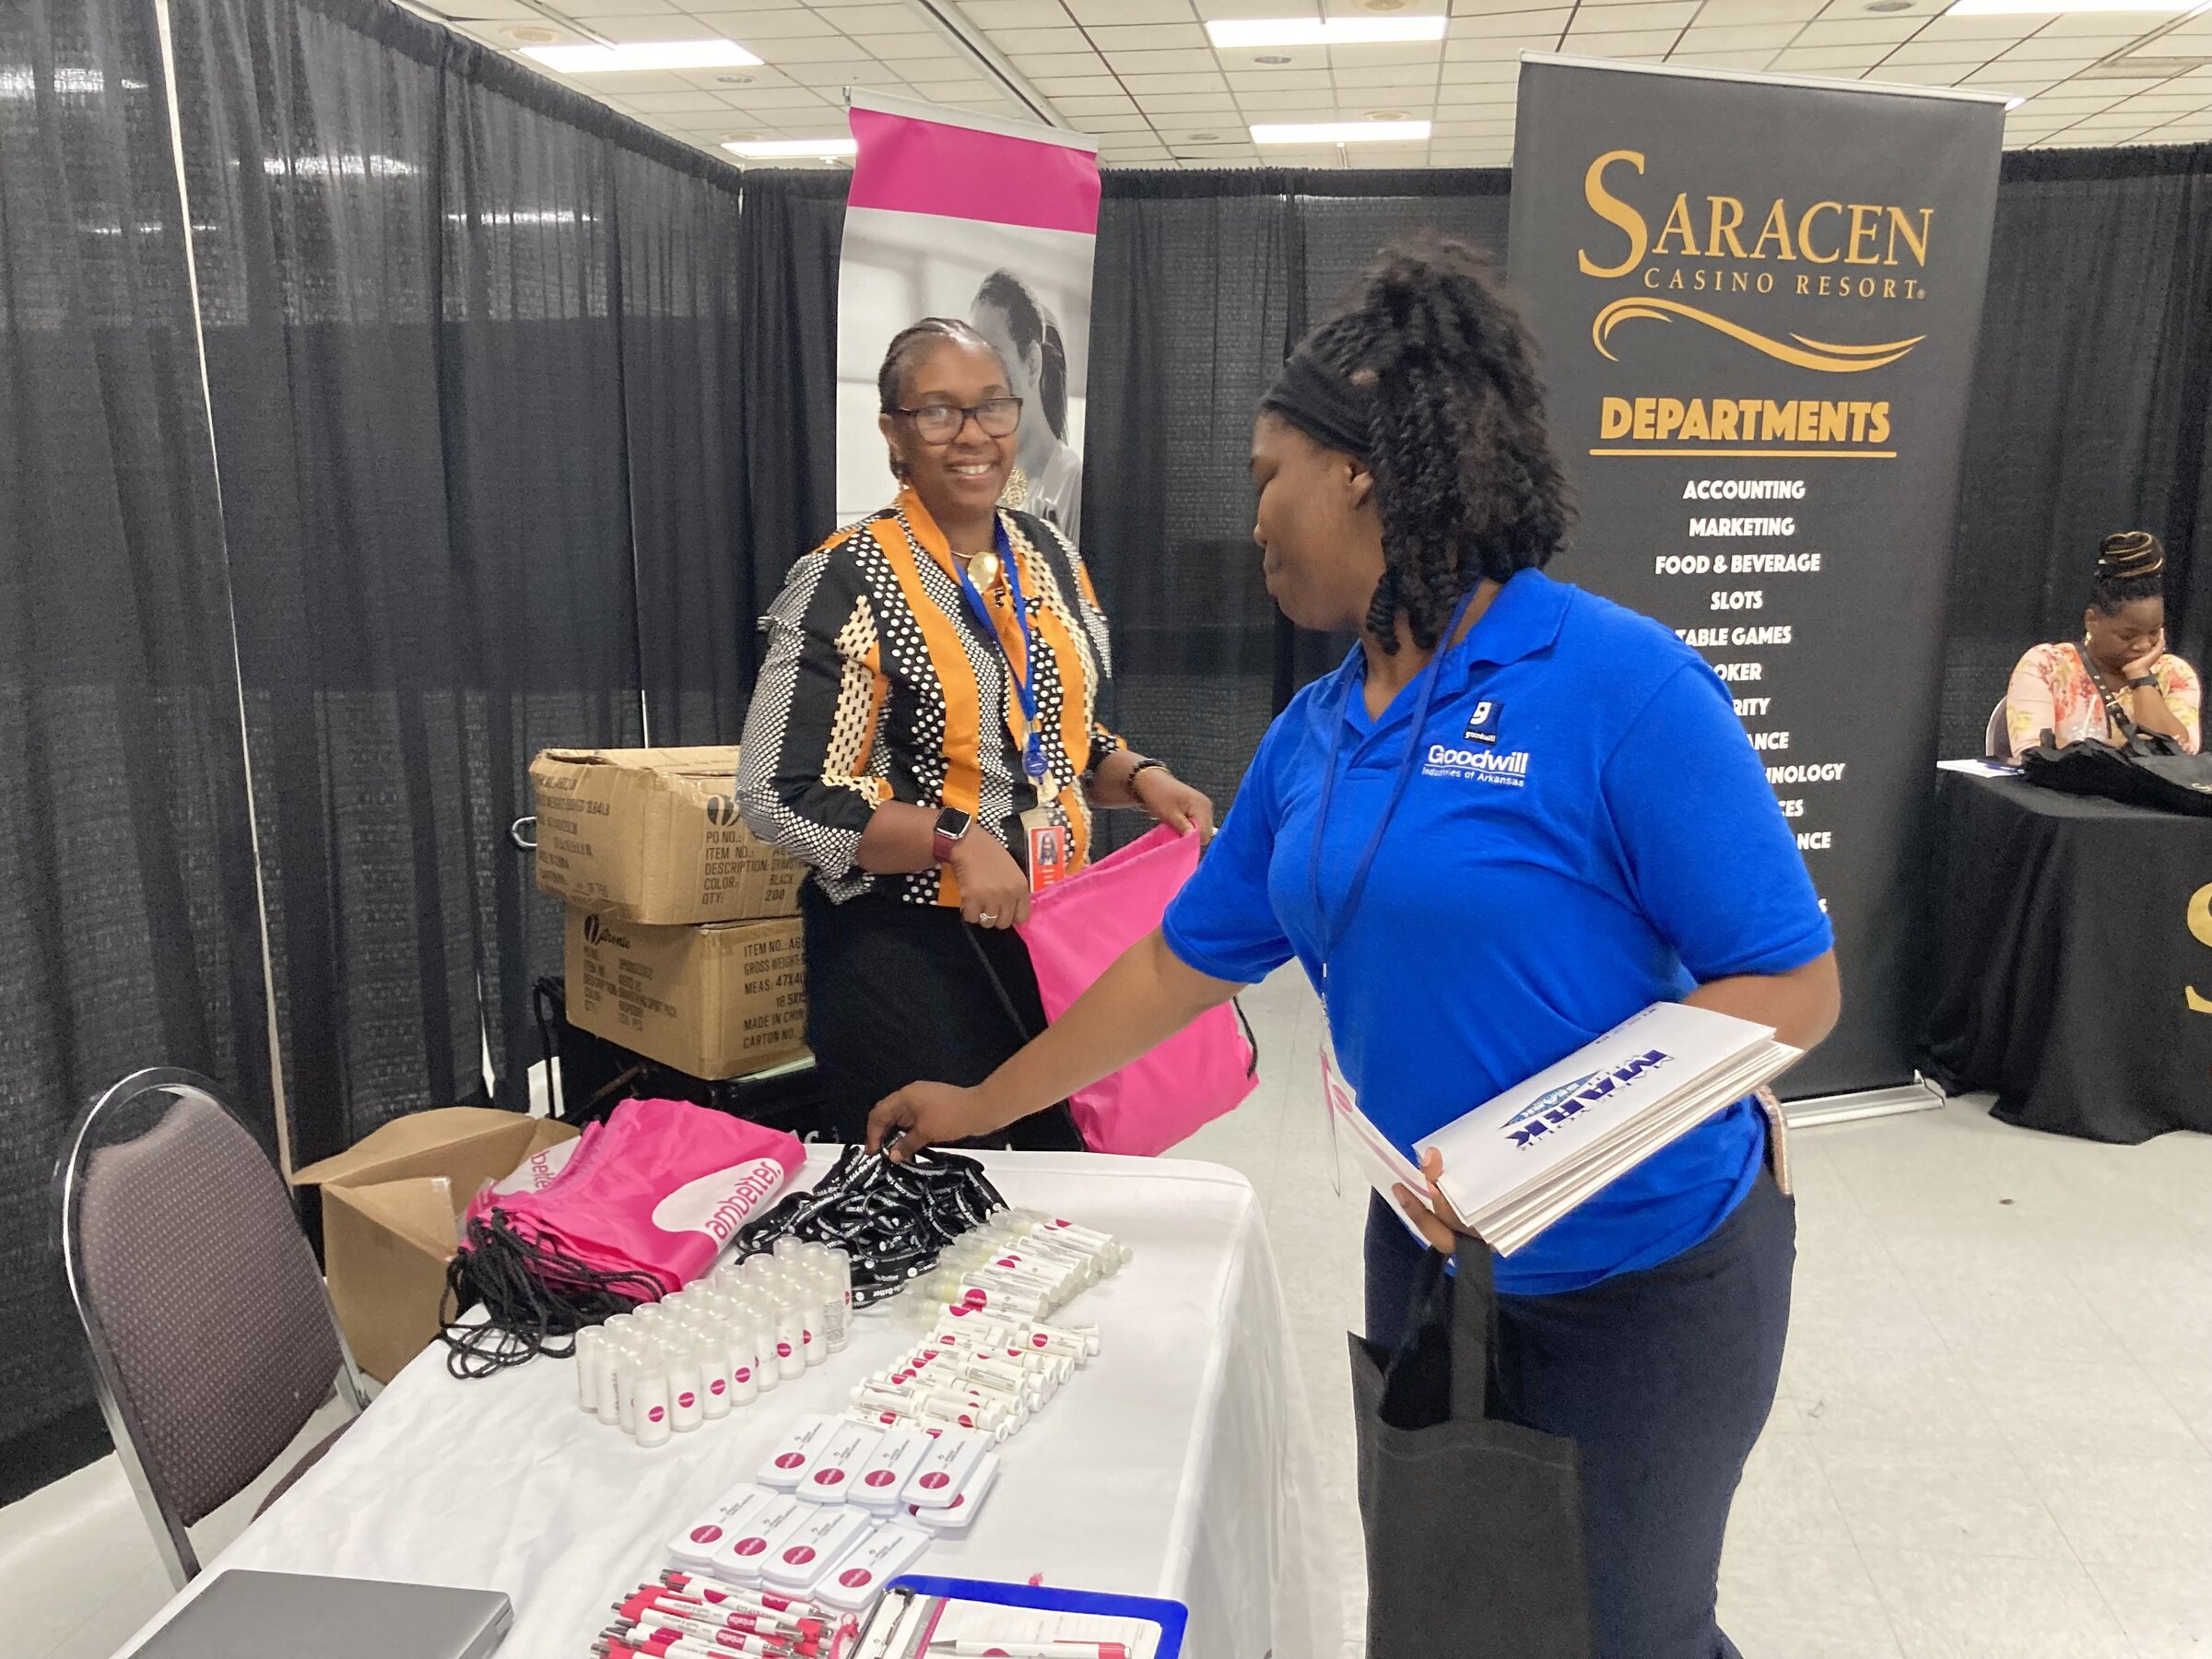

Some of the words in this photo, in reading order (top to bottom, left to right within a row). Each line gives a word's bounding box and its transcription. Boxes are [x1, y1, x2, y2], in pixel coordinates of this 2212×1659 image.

[1578, 149, 1935, 278] SARACEN
[1643, 267, 1774, 294] CASINO
[1600, 396, 1891, 443] DEPARTMENTS
[1682, 479, 1806, 500] ACCOUNTING
[1688, 516, 1795, 537] MARKETING
[1654, 555, 1711, 575] FOOD
[1712, 555, 1728, 573] &
[1730, 553, 1821, 573] BEVERAGE
[1710, 590, 1763, 611] SLOTS
[1675, 628, 1729, 647] TABLE
[1731, 625, 1792, 646] GAMES
[1713, 663, 1762, 682] OKER
[1732, 697, 1771, 716] RITY
[1465, 731, 1496, 743] goodwill
[1428, 744, 1529, 774] Goodwill
[1421, 766, 1461, 778] Industries
[1464, 771, 1475, 780] of
[1477, 772, 1524, 787] Arkansas
[705, 847, 730, 861] ITEM
[769, 874, 794, 886] BLACK
[764, 888, 785, 902] 200
[744, 942, 767, 958] ITEM
[744, 959, 770, 976] GROSS
[744, 979, 773, 995] MEAS:
[743, 1015, 770, 1031] MADE
[772, 1013, 782, 1026] IN
[742, 1030, 780, 1049] CARTON
[1505, 1049, 1668, 1148] MARK
[530, 1150, 556, 1192] bette
